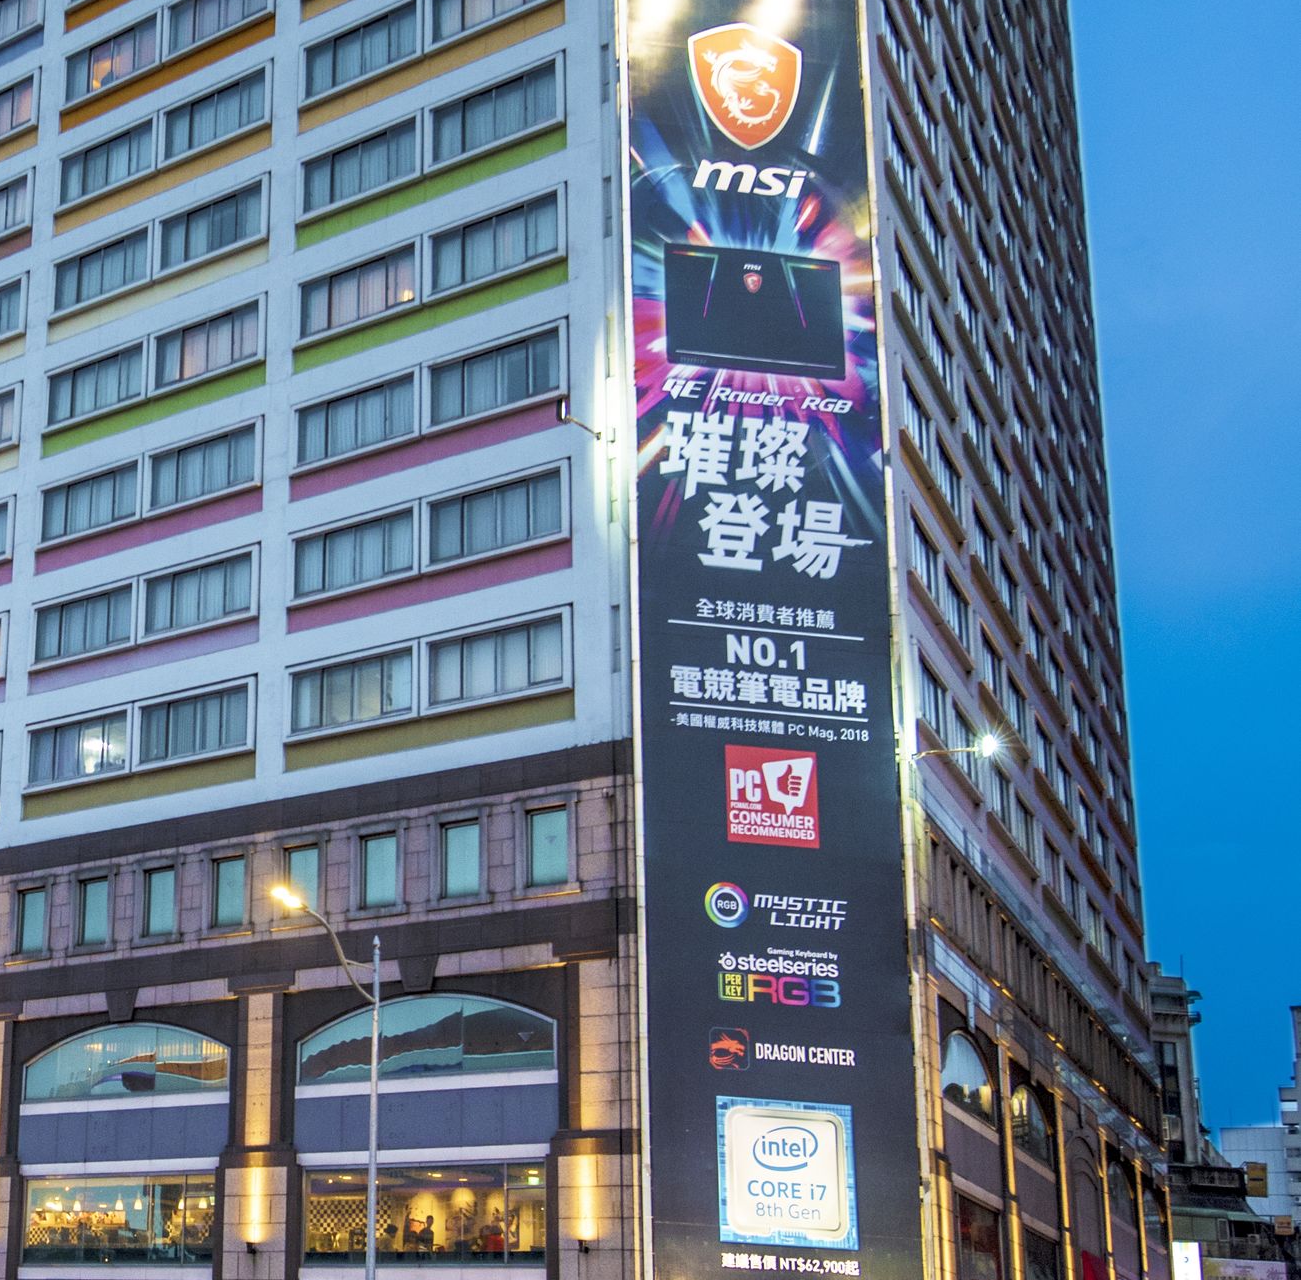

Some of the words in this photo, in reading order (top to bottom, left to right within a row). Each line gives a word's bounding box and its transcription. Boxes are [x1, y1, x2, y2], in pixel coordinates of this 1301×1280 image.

[692, 159, 807, 199] msi
[743, 263, 762, 271] msi
[711, 386, 794, 407] Raider
[801, 396, 853, 414] RGB
[659, 410, 809, 500] 璀璨
[697, 491, 873, 580] 登場
[695, 597, 835, 630] 全球消費者推薦
[726, 633, 806, 671] NO.1
[670, 665, 867, 714] 電競筆電品牌
[788, 723, 805, 736] PC
[840, 728, 869, 742] 2018
[729, 768, 761, 802] PC
[729, 810, 814, 830] CONSUMER
[730, 824, 815, 840] RECOMMENDED
[717, 900, 737, 910] RGB
[770, 912, 845, 930] LIGHT
[767, 947, 794, 957] Gaming
[795, 949, 828, 959] Keyboard
[829, 951, 838, 961] by
[737, 954, 839, 978] steelseries
[725, 974, 742, 985] PER
[725, 985, 743, 997] KEY
[747, 974, 842, 1008] RGB
[755, 1043, 806, 1063] DRAGON
[809, 1047, 856, 1066] CENTER
[761, 1135, 808, 1158] intel
[747, 1180, 802, 1200] CORE
[810, 1183, 827, 1201] i7
[755, 1202, 783, 1218] 8th
[788, 1204, 821, 1220] Gen
